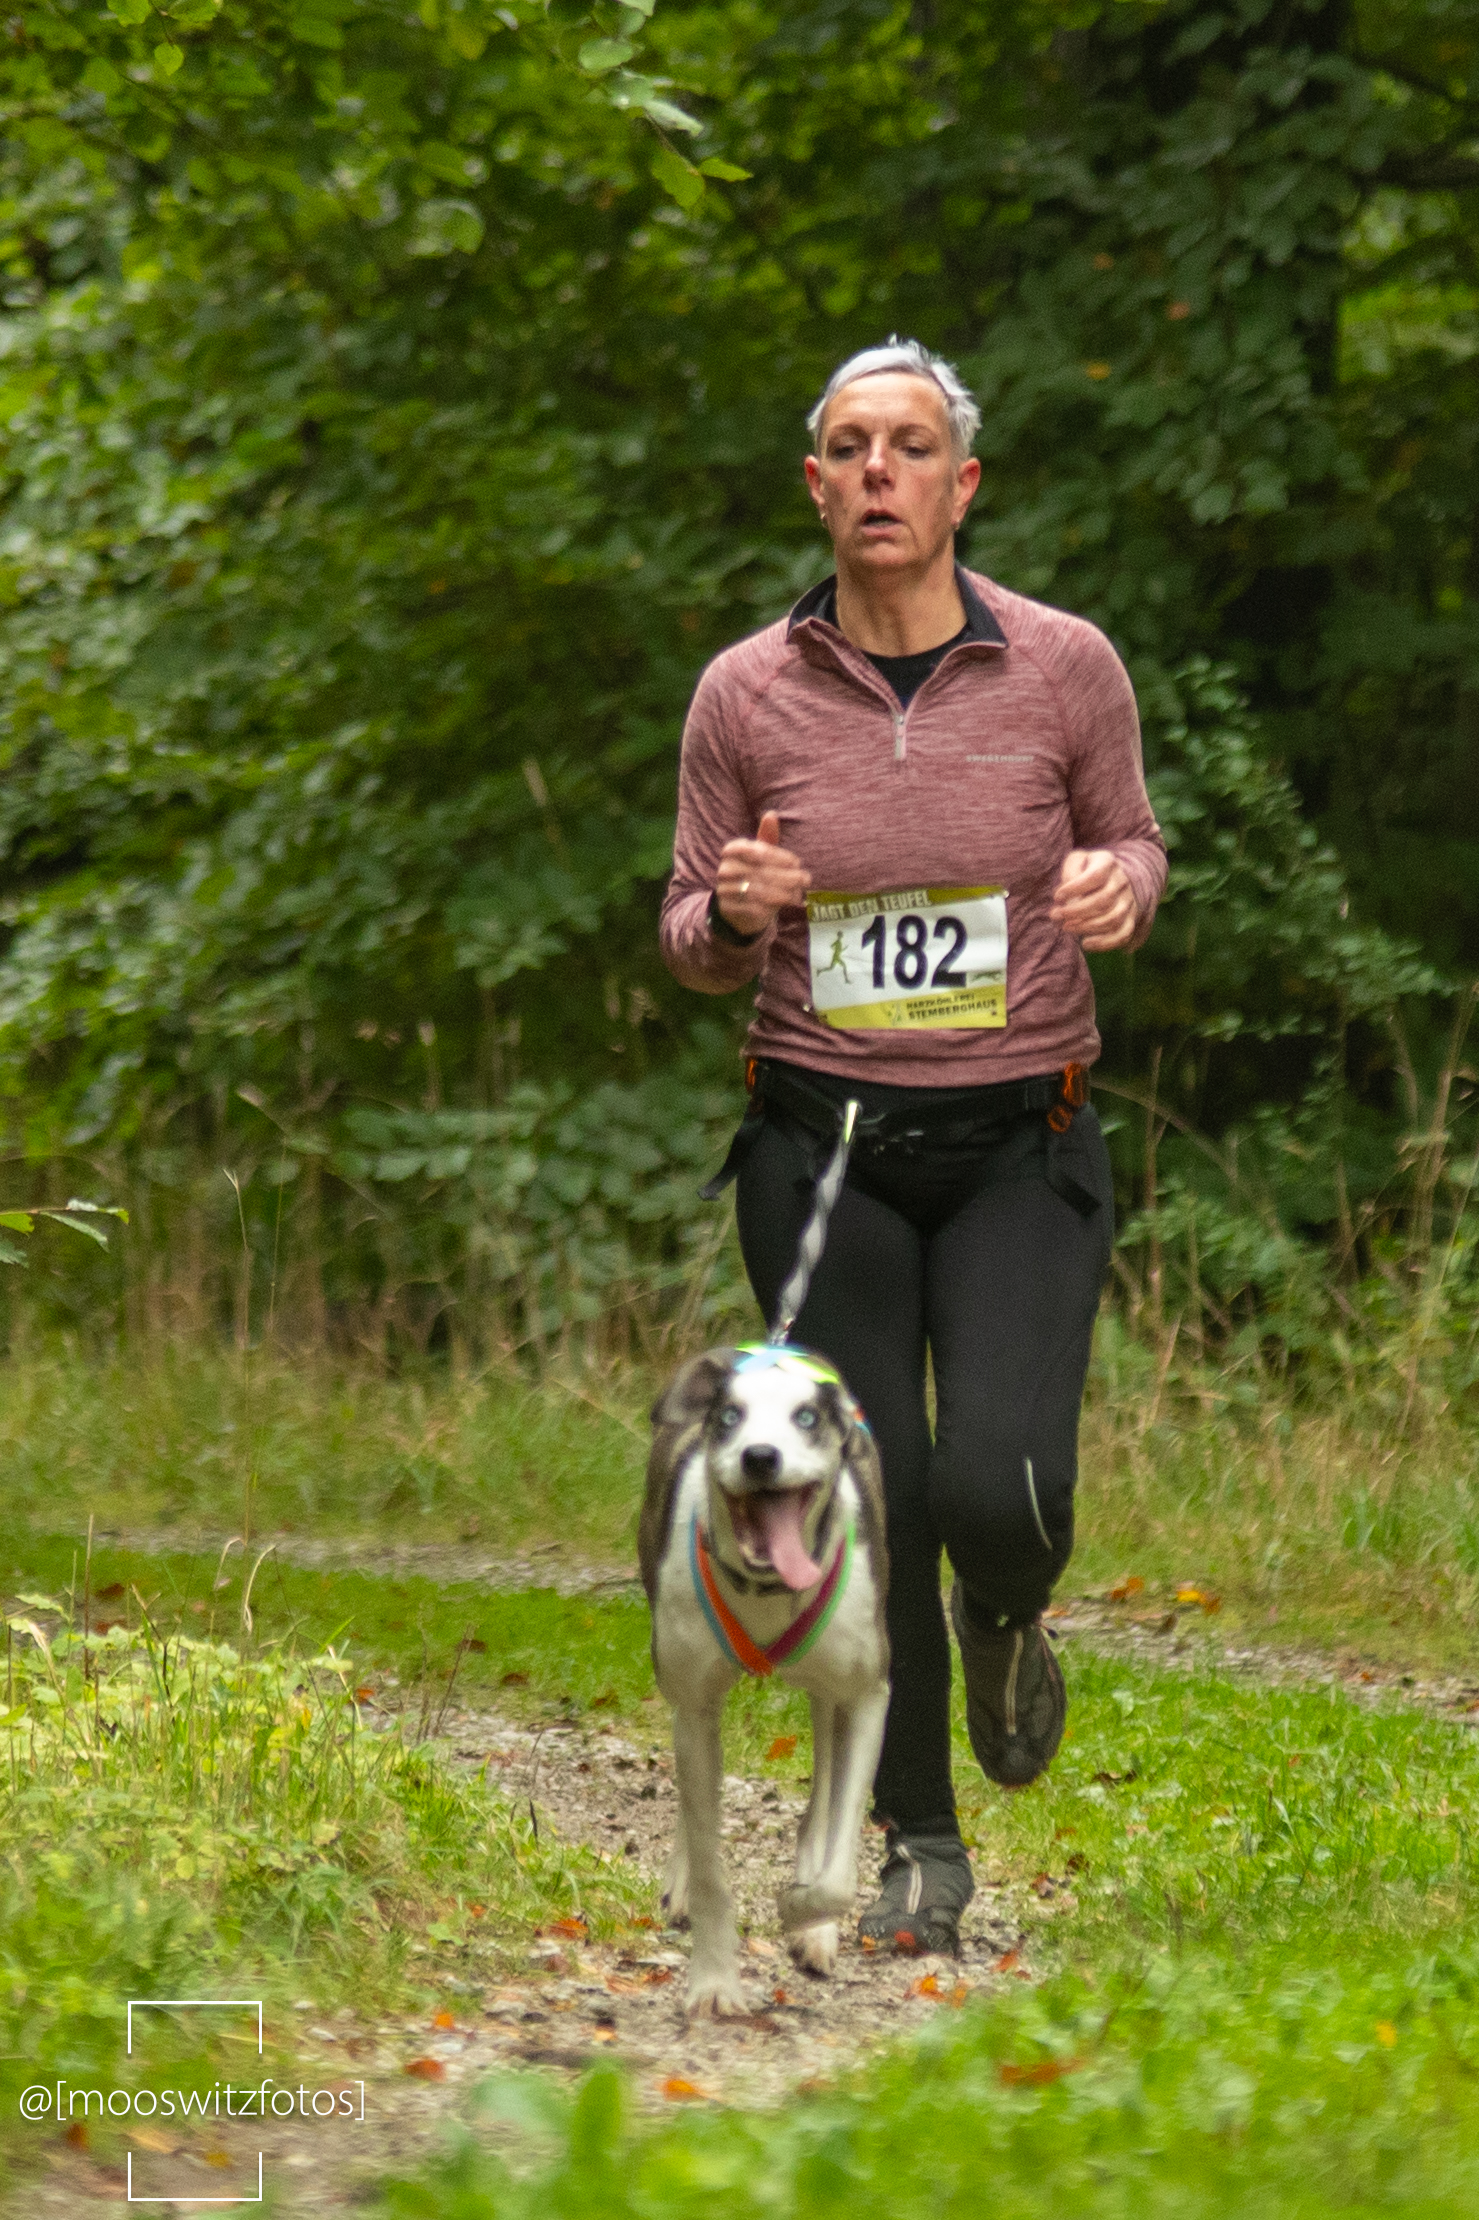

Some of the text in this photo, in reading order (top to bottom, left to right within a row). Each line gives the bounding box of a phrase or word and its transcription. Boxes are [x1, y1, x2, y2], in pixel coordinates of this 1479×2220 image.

[812, 890, 931, 921] JAGT DEN TEUFEL
[861, 915, 968, 989] 182
[908, 999, 997, 1019] STEMBERGHAUS
